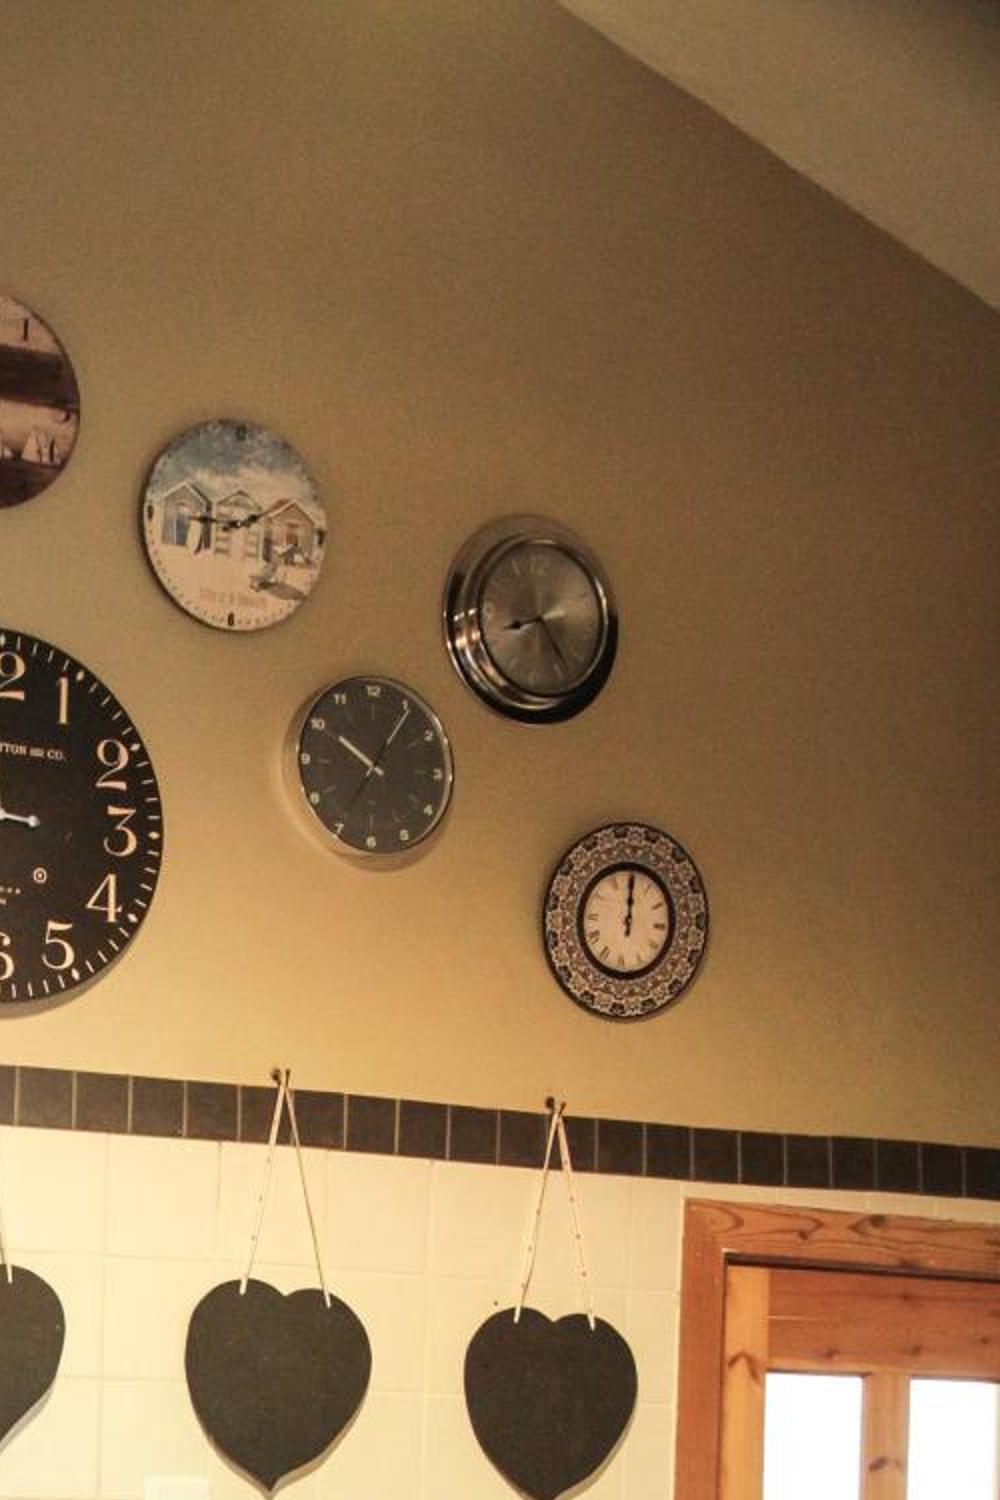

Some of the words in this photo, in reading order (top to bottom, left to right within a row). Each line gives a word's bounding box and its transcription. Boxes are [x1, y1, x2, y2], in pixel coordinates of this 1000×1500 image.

[56, 675, 69, 725] 1
[94, 738, 130, 791] 2
[102, 805, 138, 857] 3
[85, 872, 122, 923] 4
[41, 919, 76, 970] 5
